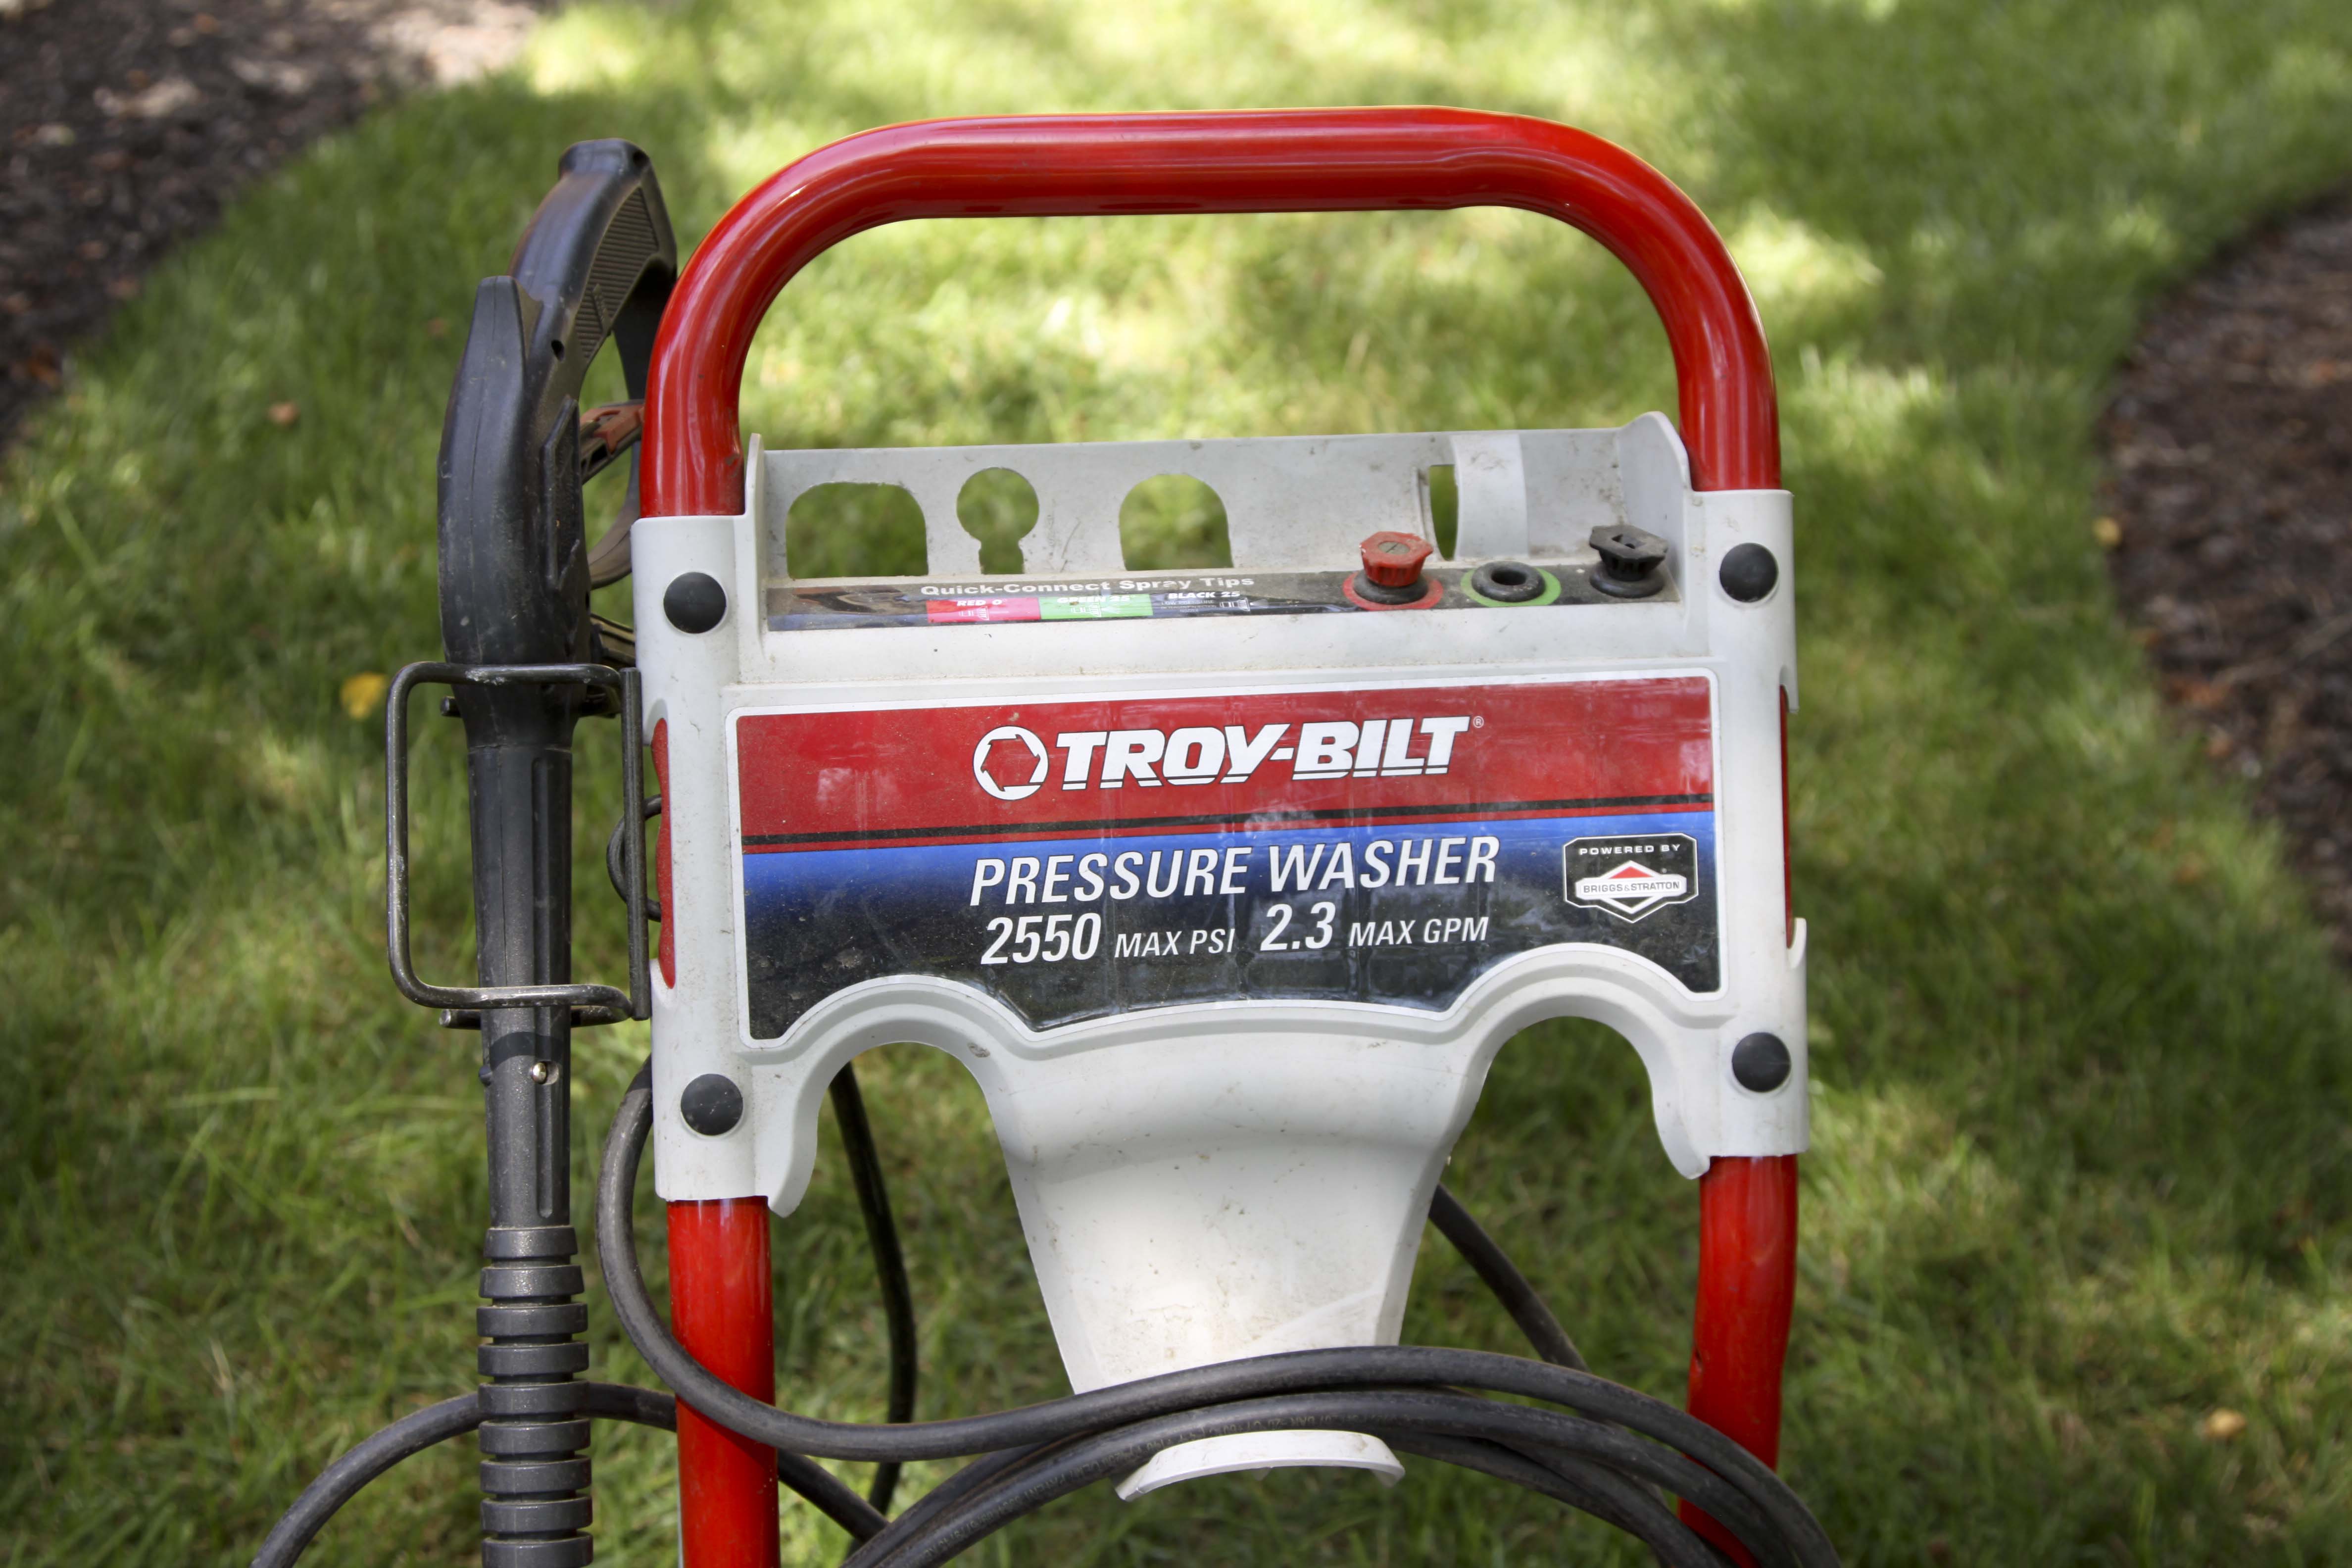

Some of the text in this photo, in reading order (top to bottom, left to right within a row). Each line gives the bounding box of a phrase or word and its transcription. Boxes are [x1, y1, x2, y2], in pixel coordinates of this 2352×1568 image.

[921, 577, 1255, 595] Quick-Connect Spray Tips
[1578, 845, 1654, 855] POWERED
[970, 835, 1500, 906] PRESSURE WASHER
[1583, 881, 1680, 893] BRIGGS&STRATTON
[980, 901, 1489, 965] 2550 MAX PSI 2.3 MAX GPM
